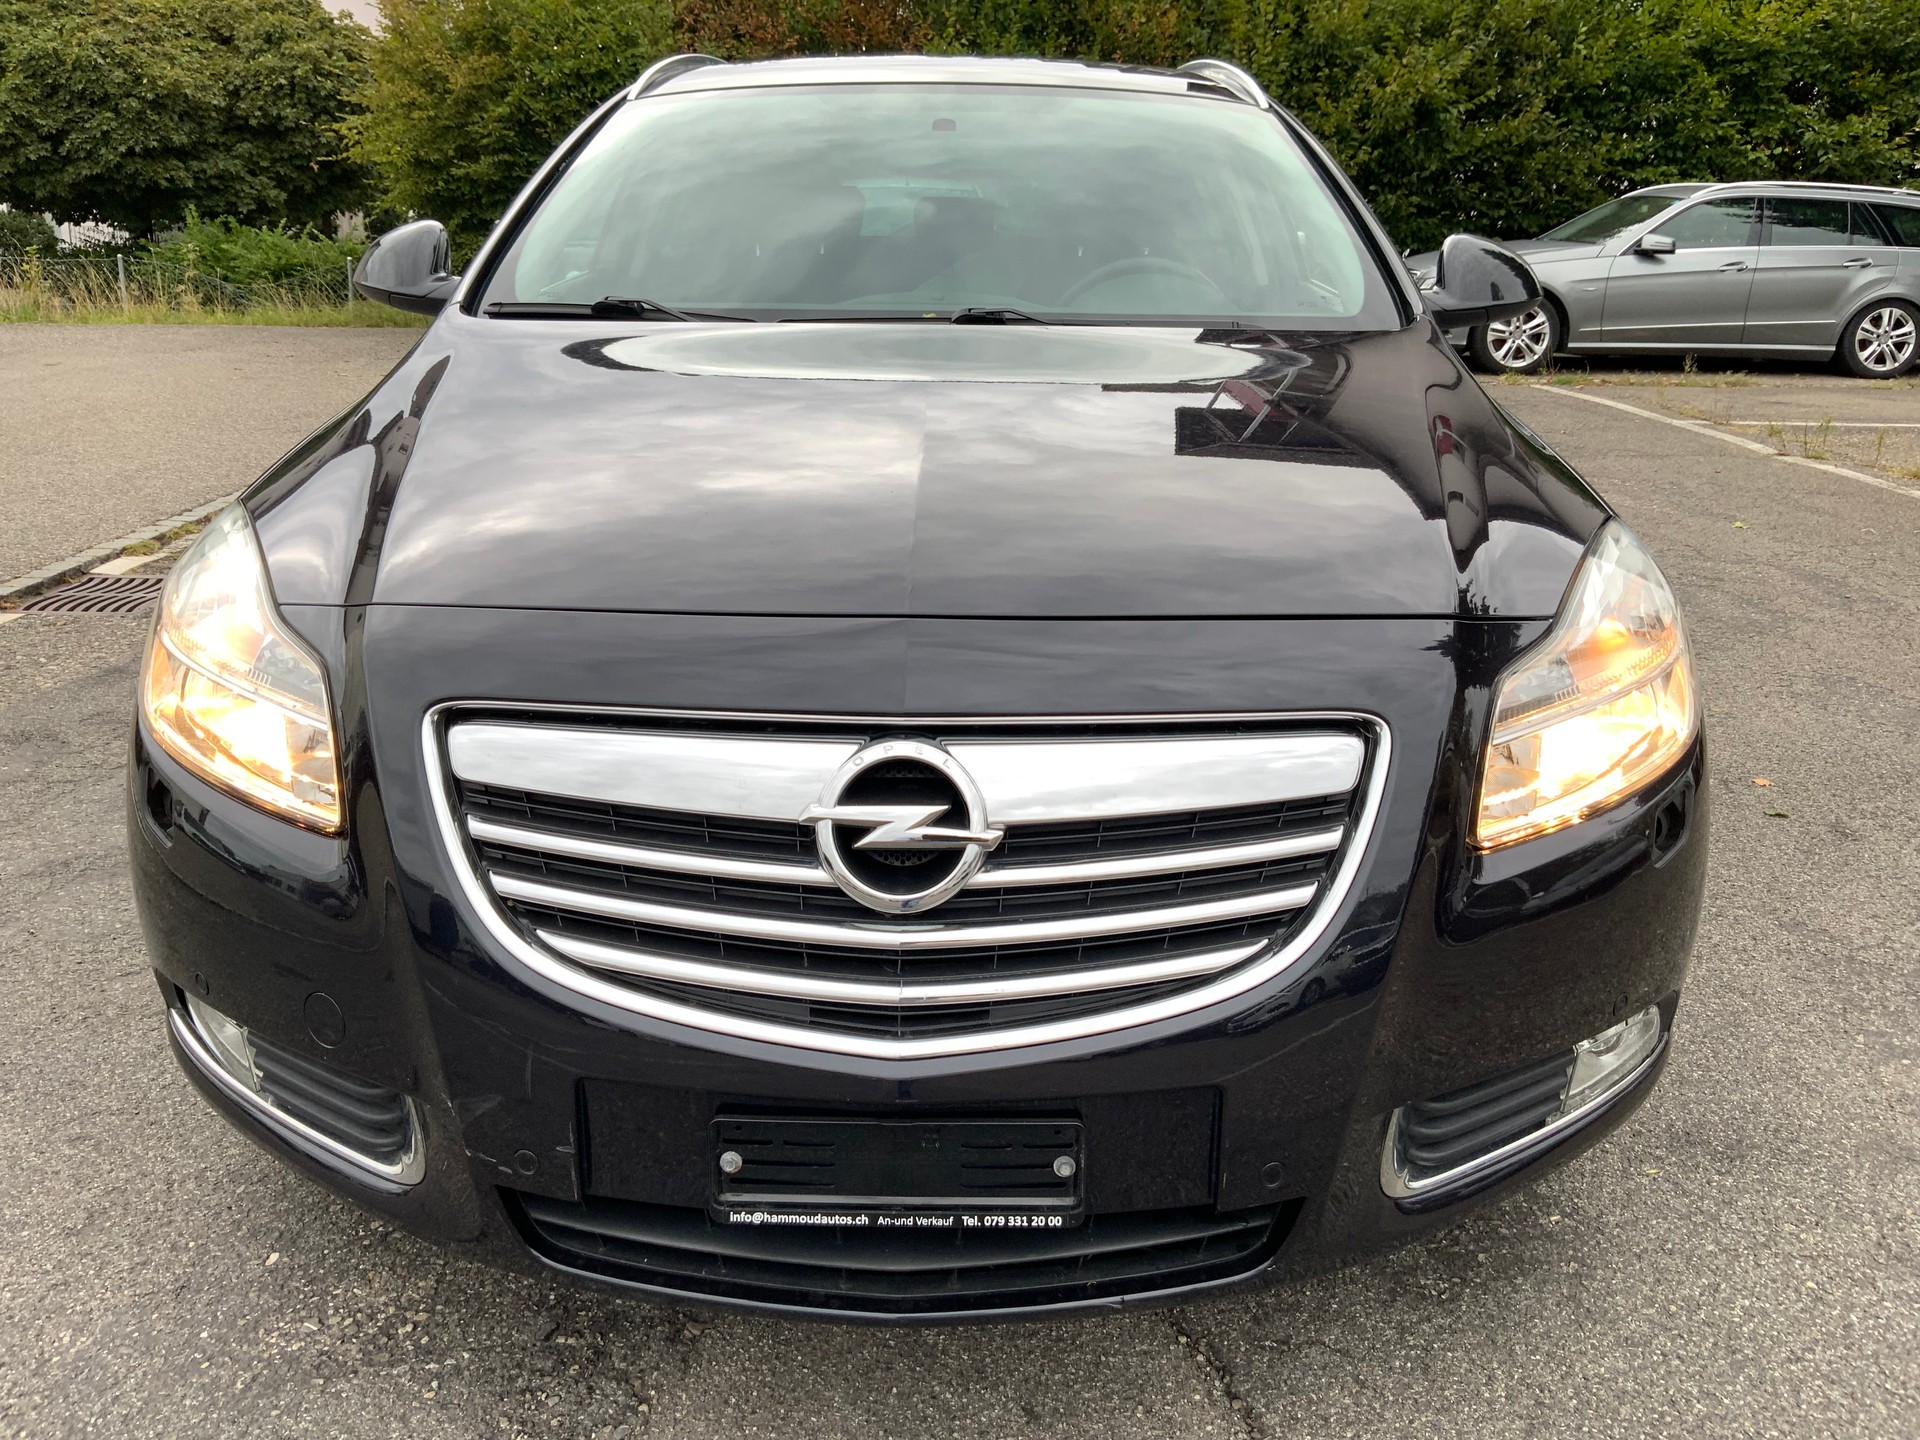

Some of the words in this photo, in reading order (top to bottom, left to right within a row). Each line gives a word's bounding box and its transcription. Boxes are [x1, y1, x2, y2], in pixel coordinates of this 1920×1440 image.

[852, 745, 951, 770] OPEL
[877, 1216, 913, 1226] An-und
[915, 1215, 954, 1226] Verkauf
[961, 1215, 981, 1226] Tel.
[984, 1215, 1005, 1226] 079
[1007, 1215, 1029, 1226] 331
[1031, 1215, 1046, 1226] 20
[1047, 1215, 1062, 1226] 00
